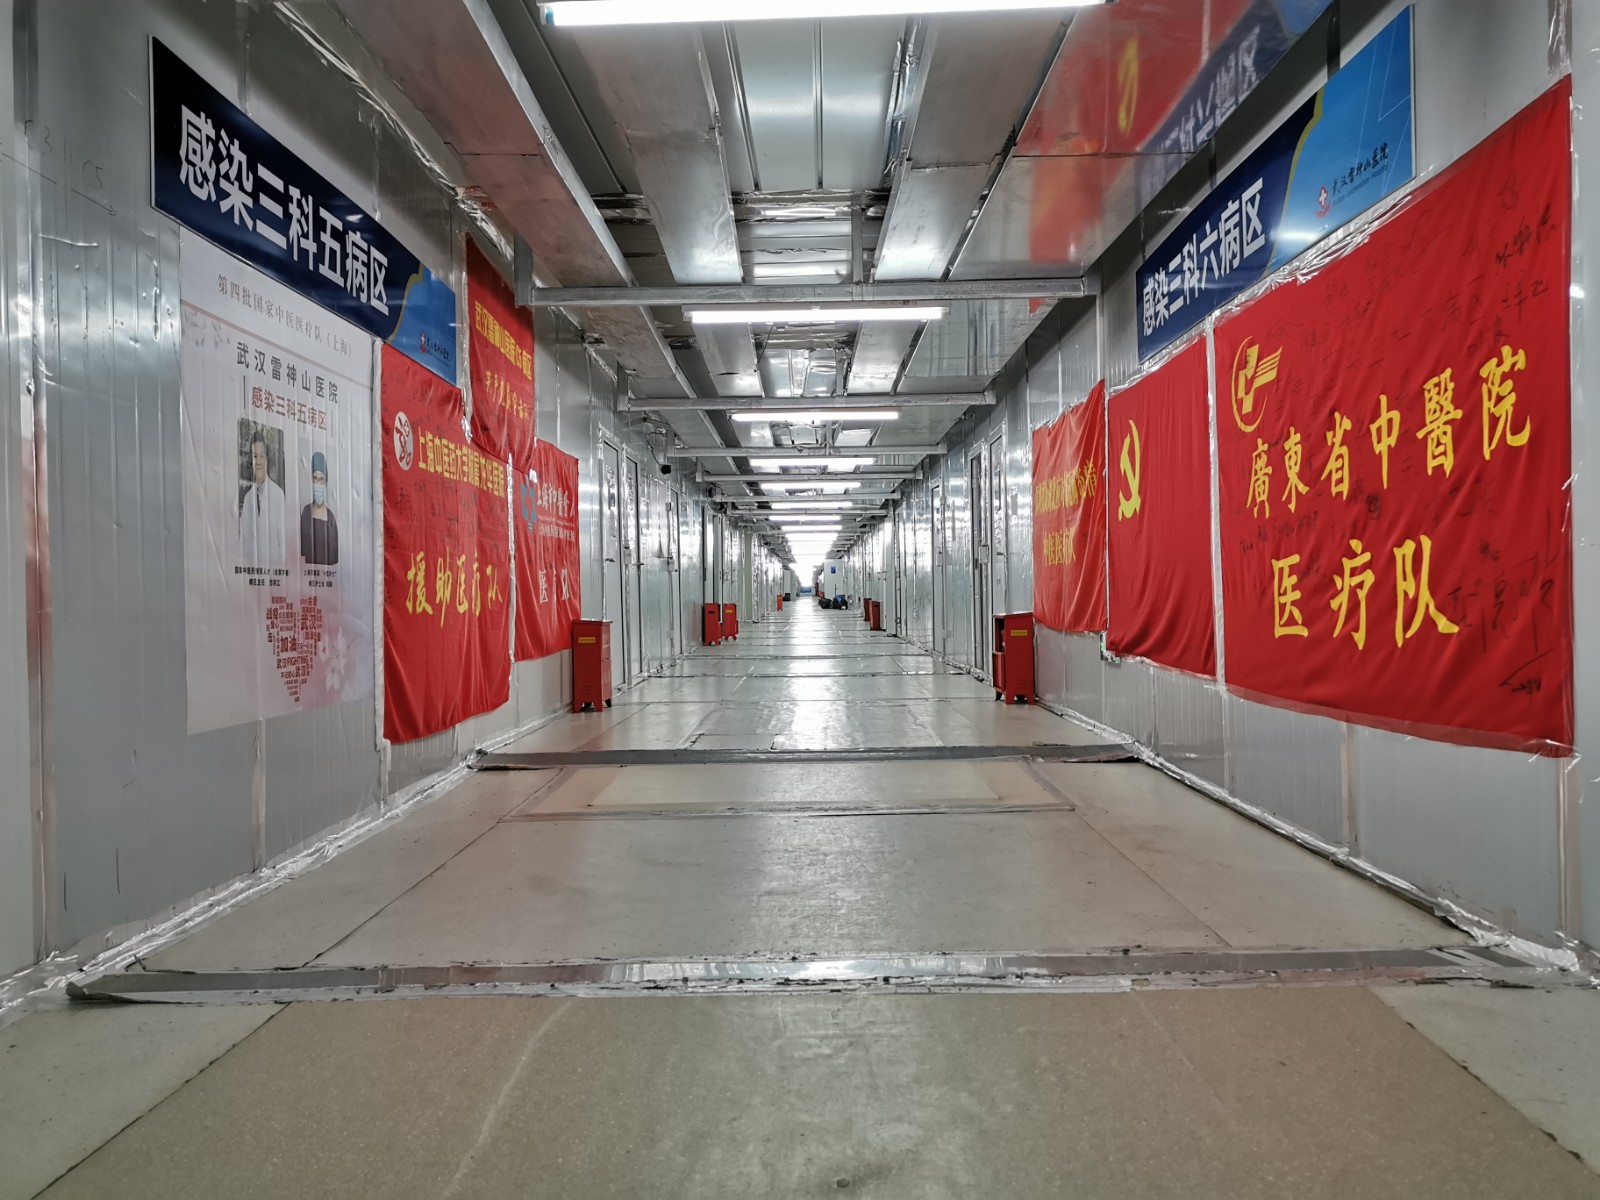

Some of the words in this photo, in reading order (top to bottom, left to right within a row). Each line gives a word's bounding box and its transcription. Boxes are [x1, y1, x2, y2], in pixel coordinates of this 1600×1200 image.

[179, 104, 390, 317] 感染三科五病区
[1142, 177, 1266, 337] 感染三科六病区
[236, 341, 339, 404] 武汉雷神山医院
[251, 385, 327, 431] 感染三科五病区
[1246, 345, 1531, 519] 廣東省中醫院
[301, 614, 316, 631] 武汉
[1271, 534, 1459, 650] 医疗队
[280, 634, 297, 653] 加油
